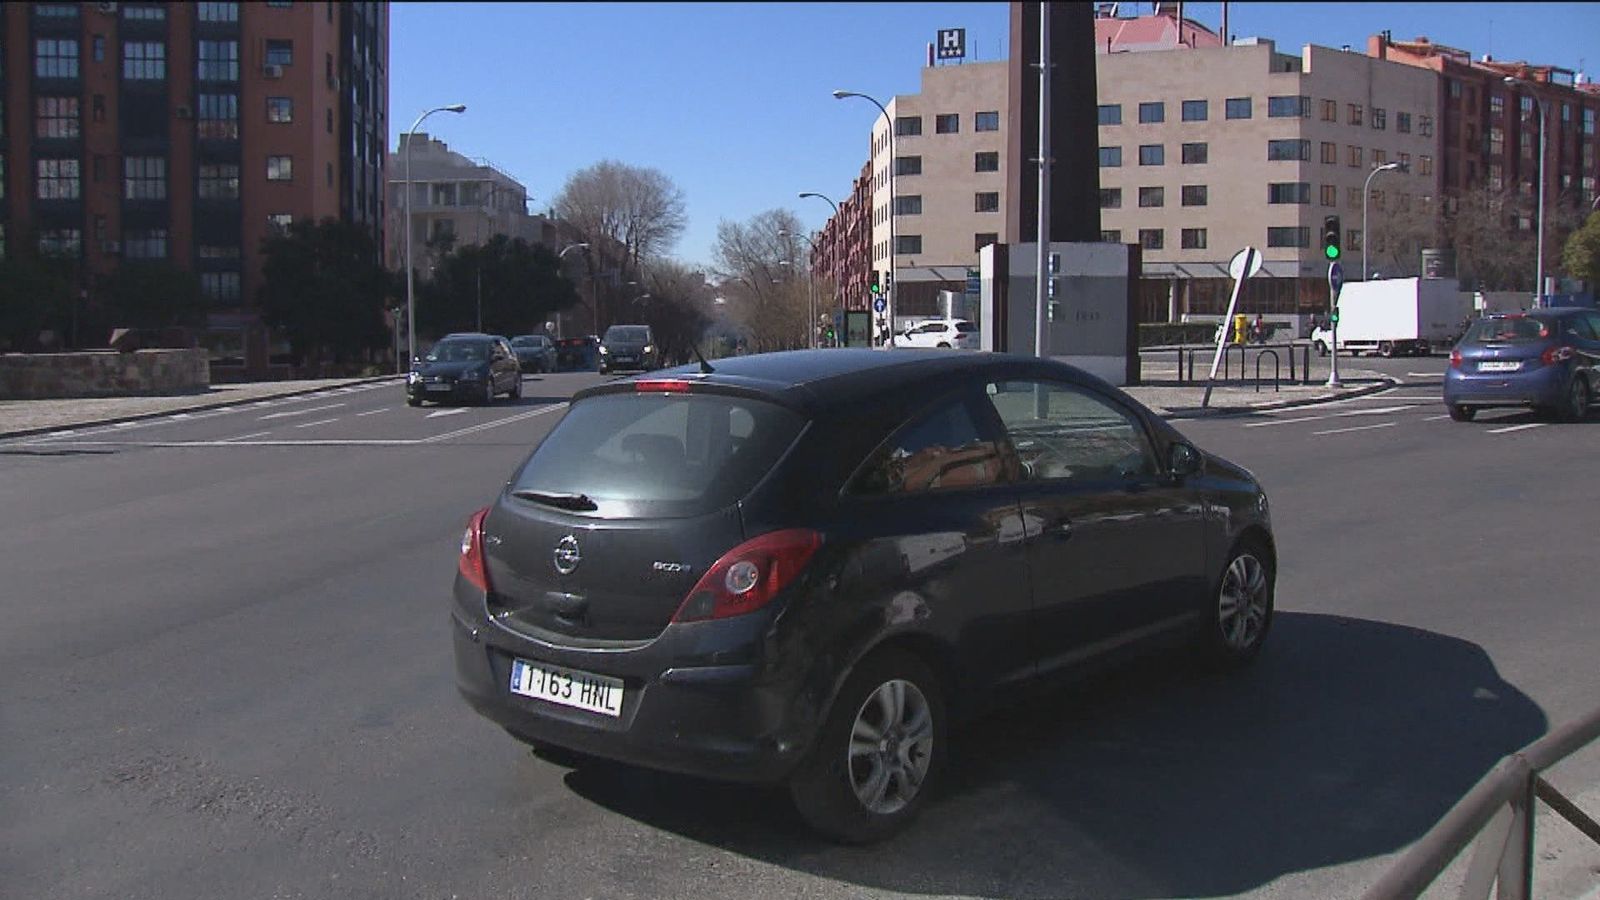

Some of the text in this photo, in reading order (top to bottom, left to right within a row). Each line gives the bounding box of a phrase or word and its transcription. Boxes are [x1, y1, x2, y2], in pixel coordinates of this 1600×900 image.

[943, 30, 959, 48] H
[527, 665, 616, 711] 1163 HNL
